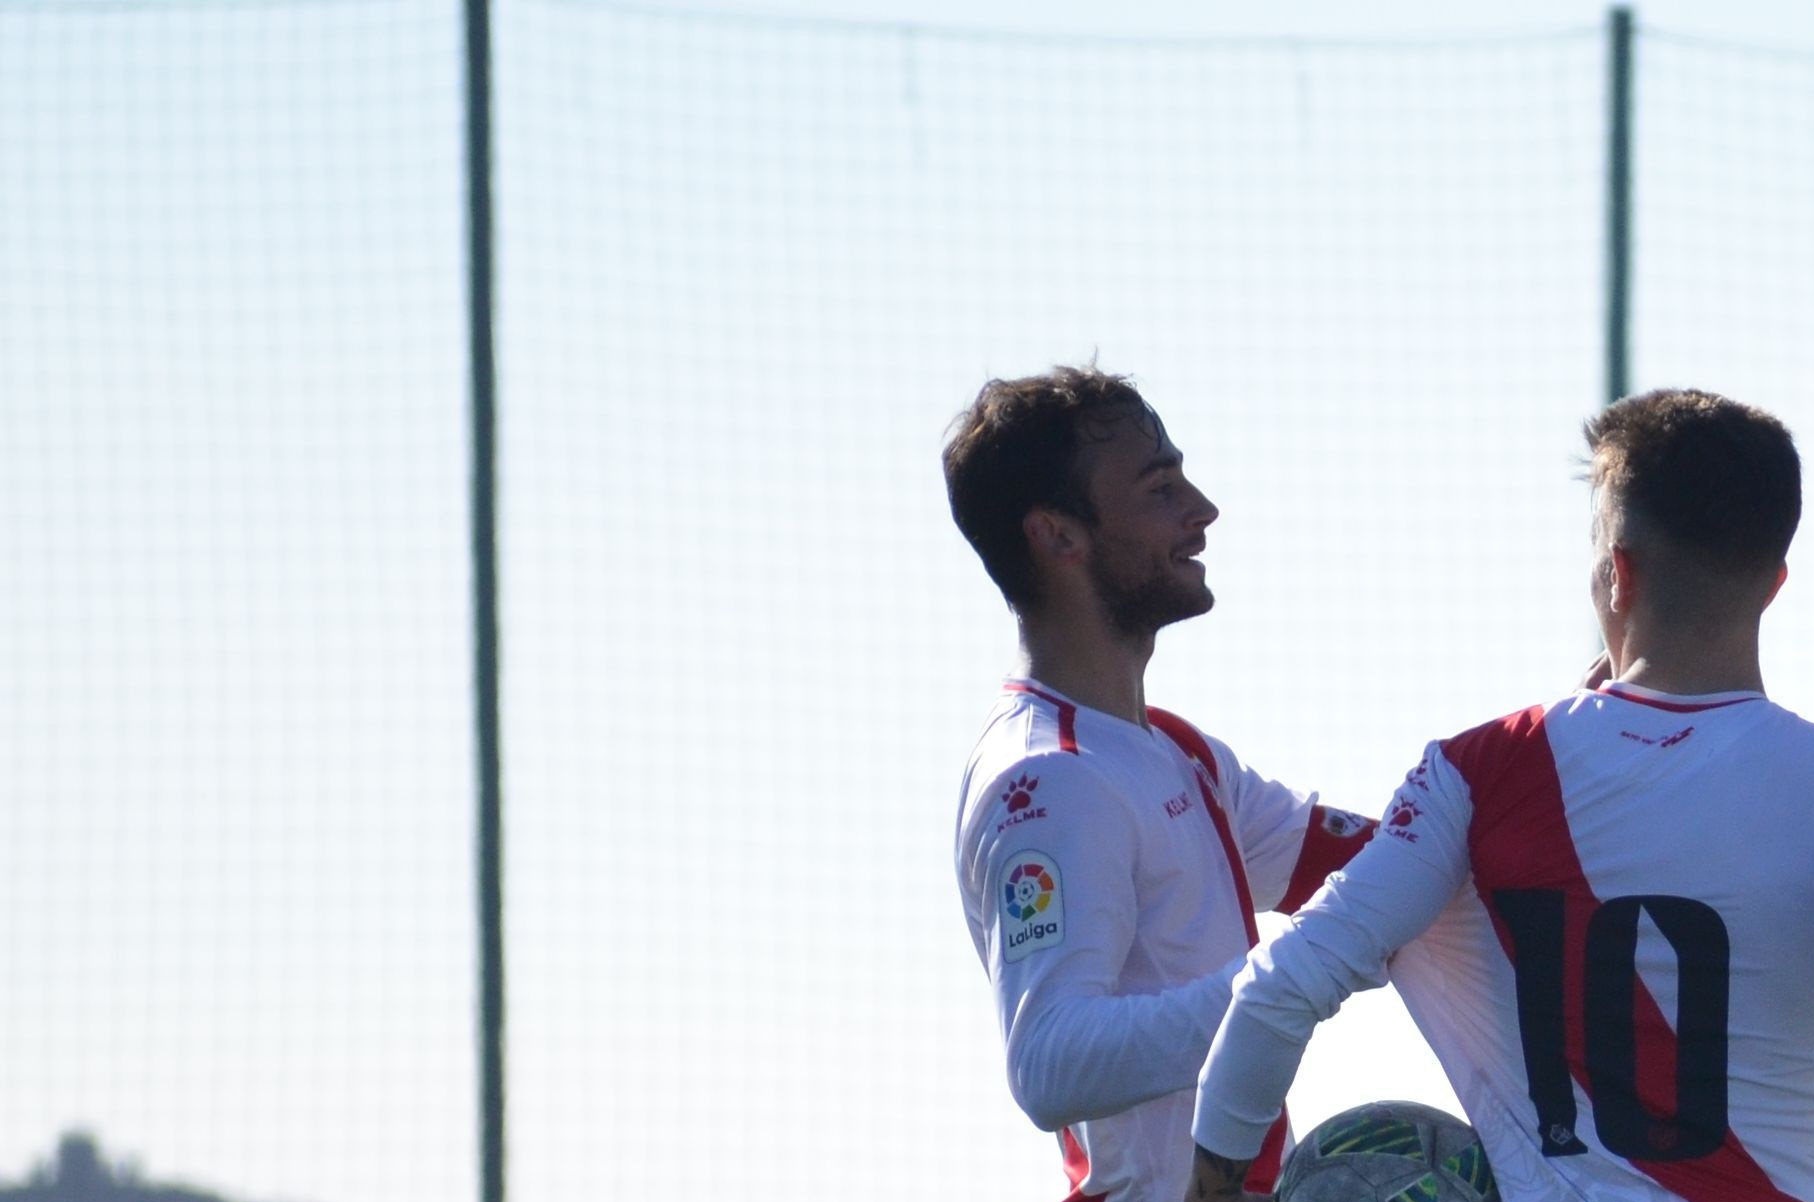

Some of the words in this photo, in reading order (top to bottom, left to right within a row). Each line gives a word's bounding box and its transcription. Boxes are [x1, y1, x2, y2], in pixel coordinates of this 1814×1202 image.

[997, 807, 1047, 833] KELME
[1009, 922, 1058, 948] LaLiga
[1492, 888, 1730, 1162] 10
